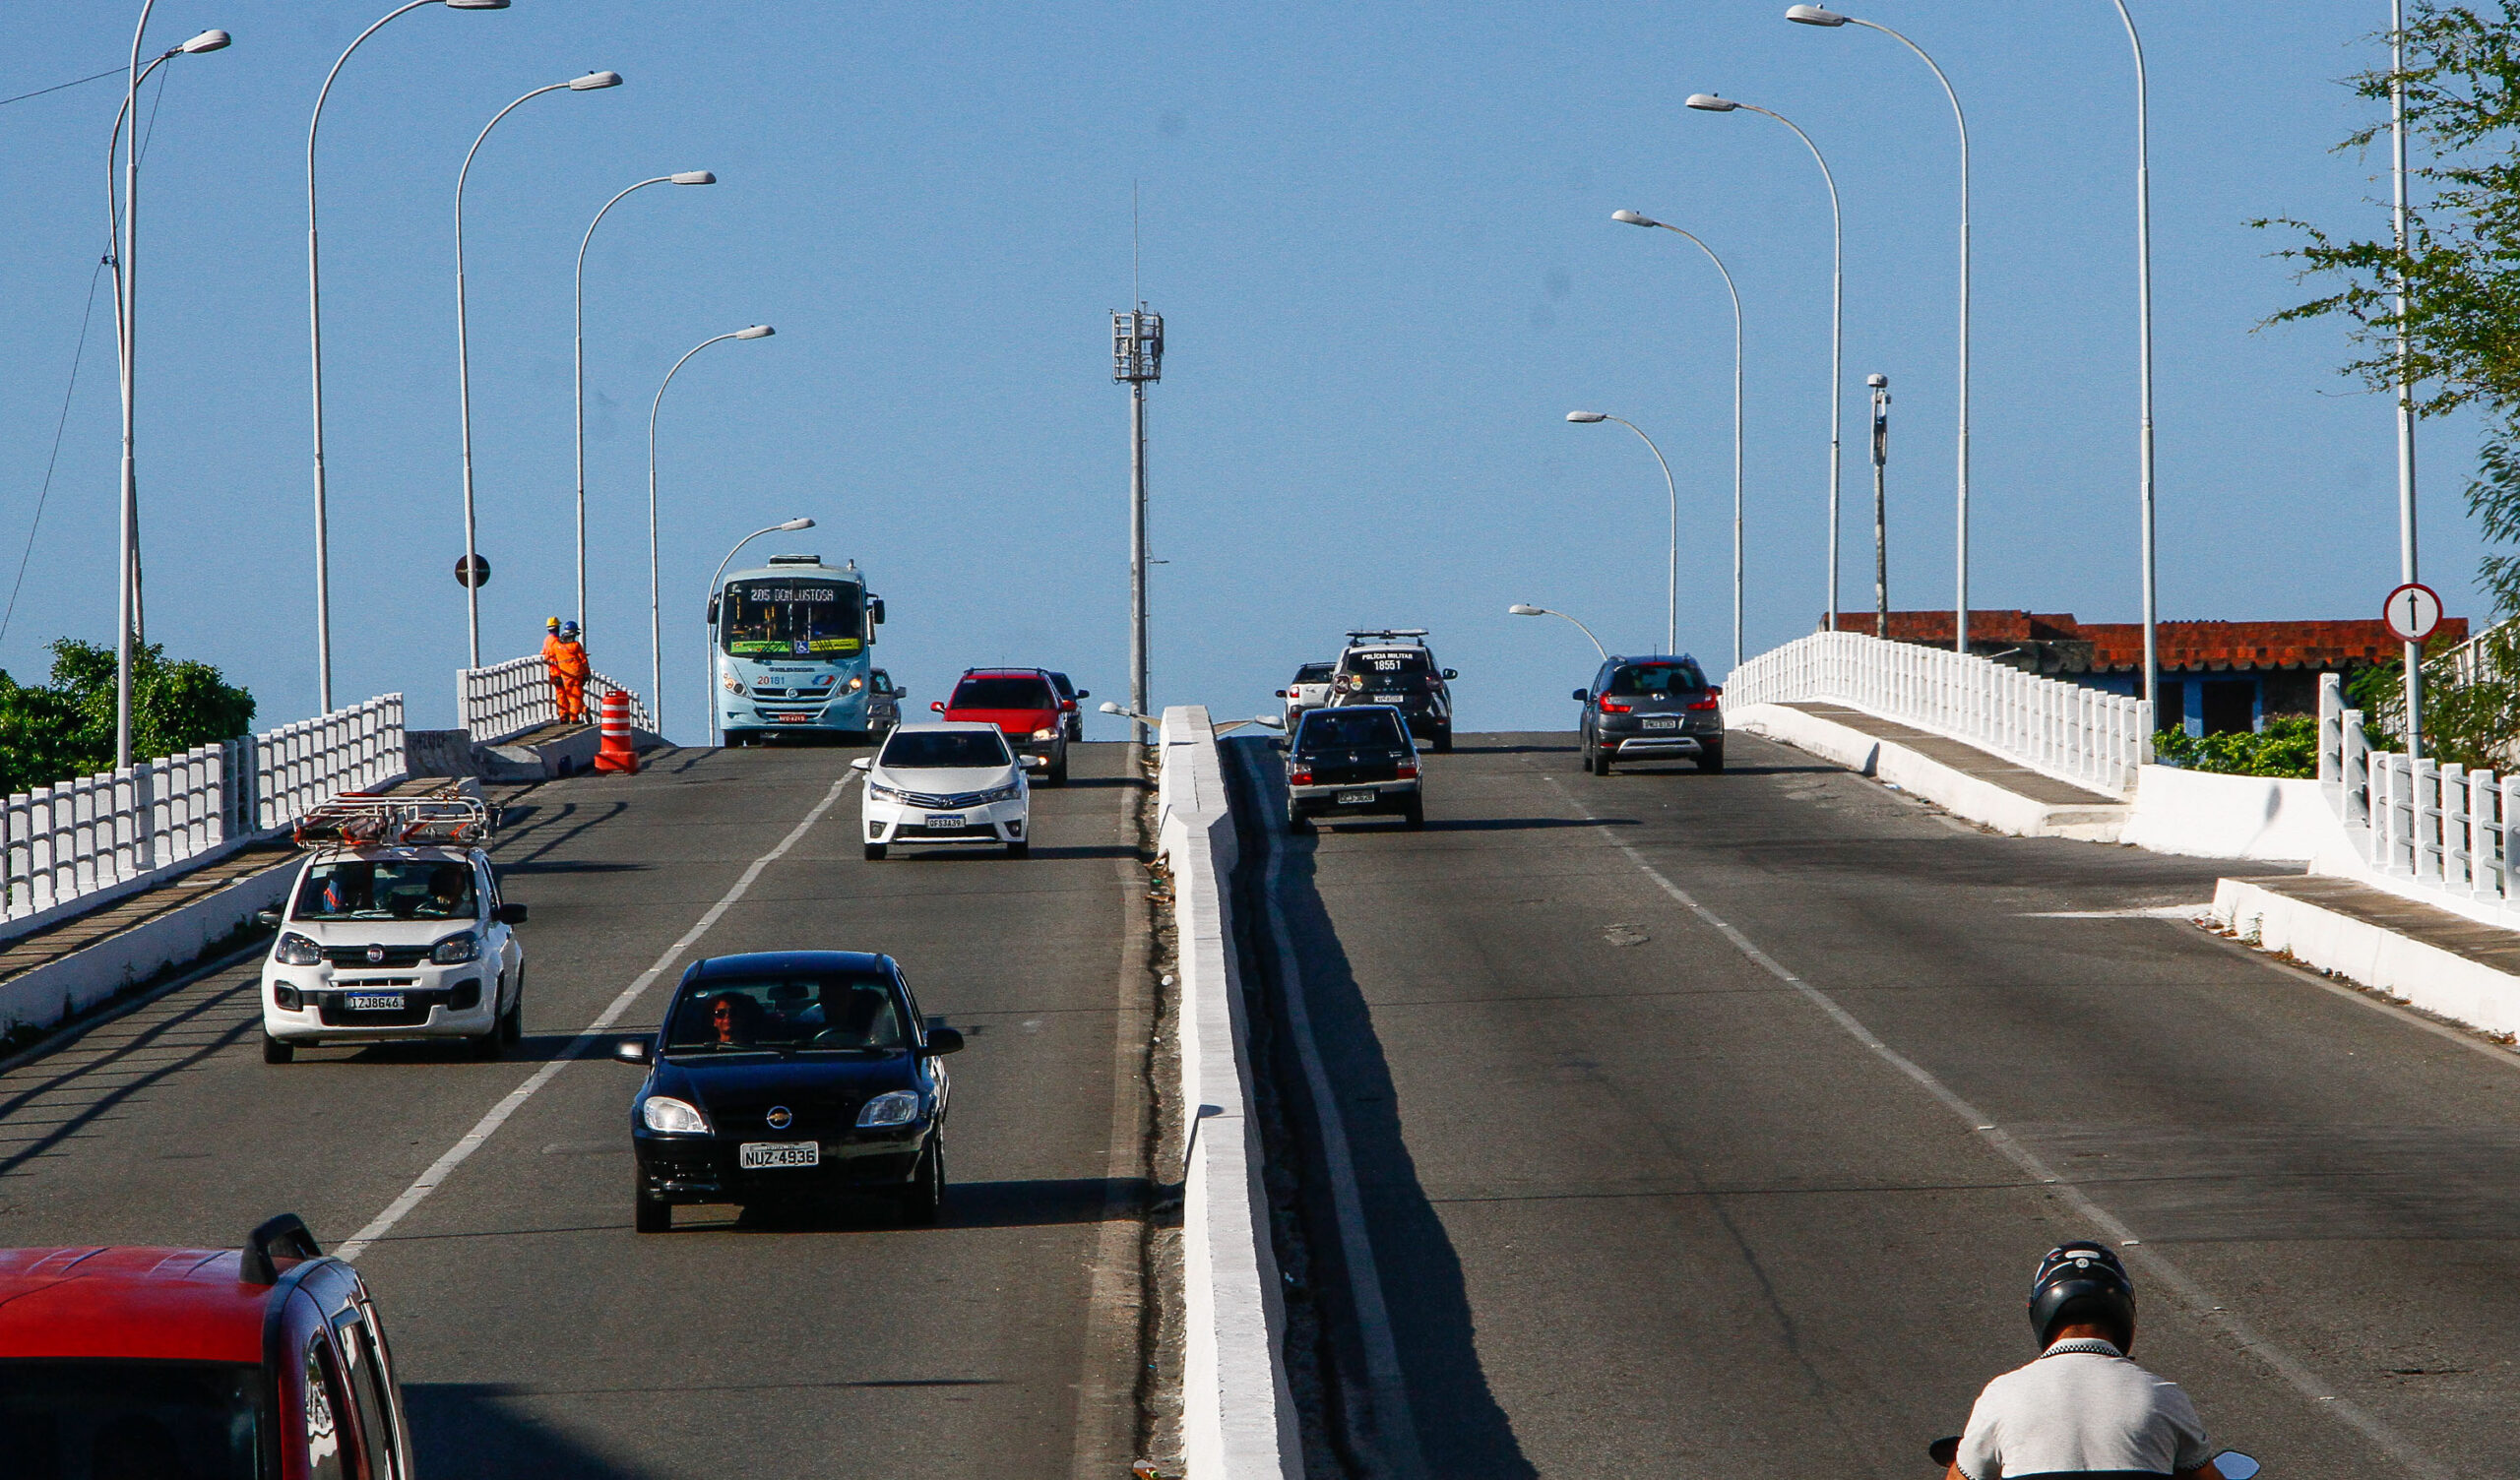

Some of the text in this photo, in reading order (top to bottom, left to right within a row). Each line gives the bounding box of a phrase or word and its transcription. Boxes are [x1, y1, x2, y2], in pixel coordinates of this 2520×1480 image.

[751, 588, 771, 601] 205
[1374, 660, 1401, 671] 18551
[757, 676, 785, 685] 20181
[352, 997, 399, 1009] IZJ8G46
